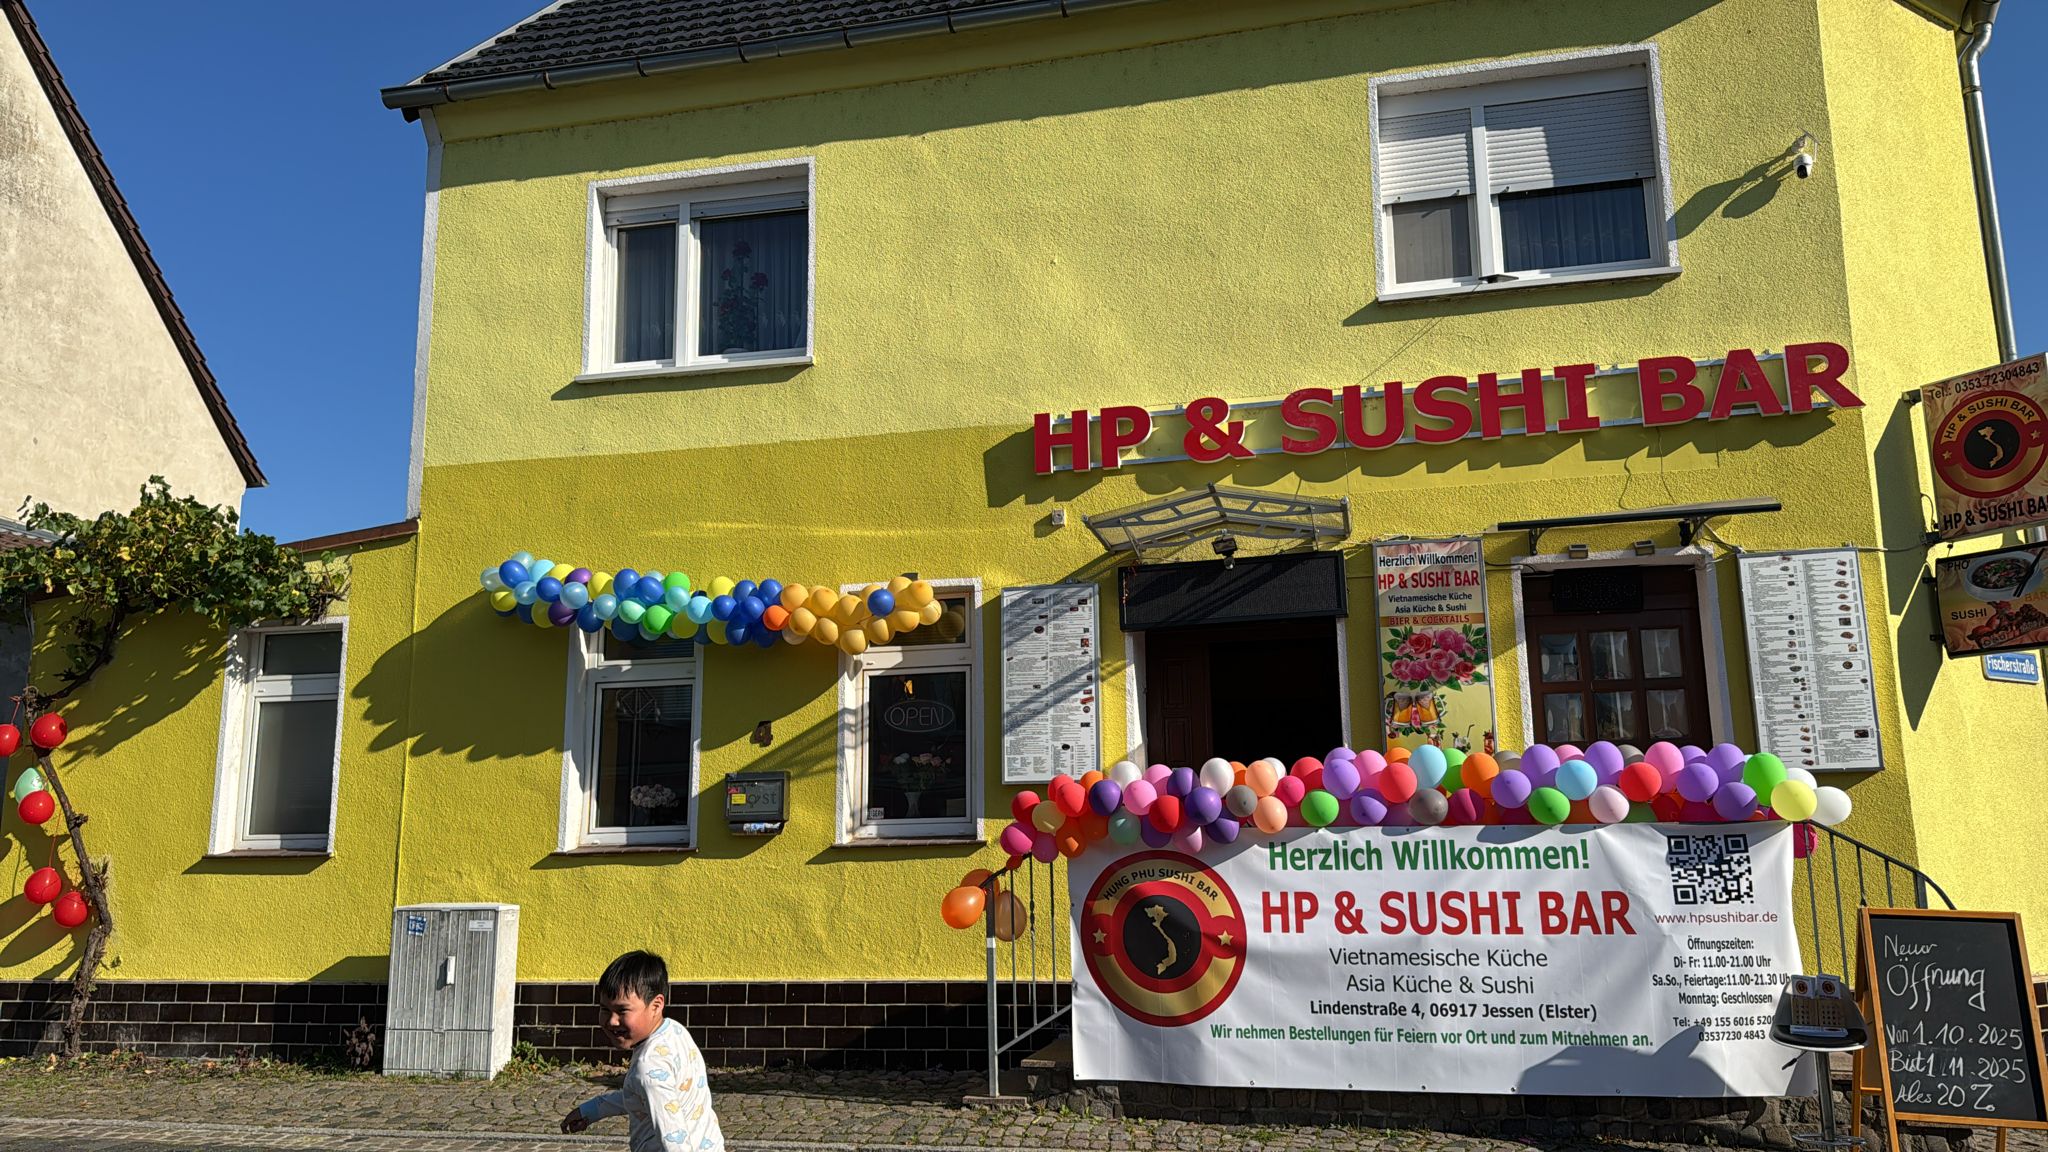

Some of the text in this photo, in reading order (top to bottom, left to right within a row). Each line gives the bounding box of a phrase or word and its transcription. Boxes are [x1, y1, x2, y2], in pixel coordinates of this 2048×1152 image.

[1034, 342, 1866, 476] HP & SUSHI BAR
[1944, 398, 2035, 439] HP & SUSHI BAR
[1943, 495, 2048, 531] HP & SUSHI BA
[1379, 552, 1477, 567] Herzlich Willkommen!
[1378, 570, 1480, 590] HP & SUSHI BAR
[1388, 591, 1473, 603] Vietnamesische Küche
[1395, 603, 1467, 614] Asia Küche & Sushi
[1951, 608, 1987, 620] SUSHI
[1390, 615, 1470, 626] BIER & COCKTAILS
[1986, 655, 2035, 675] Fischerstraße
[890, 706, 944, 727] OPEN
[751, 720, 773, 747] 4
[1269, 839, 1590, 871] Herzlich Willkommen!
[1103, 868, 1218, 901] HUNG PHU SUSHI BAR
[1262, 890, 1638, 936] HP & SUSHI BAR
[1654, 911, 1778, 926] www.hpsushibar.de
[1687, 935, 1755, 953] Öffnungszeiten:
[1329, 947, 1548, 967] Vietnamesische Küche
[1674, 955, 1771, 968] Di- Fr: 11.00-21.00 Uhr
[1346, 975, 1534, 994] Asia Küche & Sushi
[1652, 974, 1682, 988] Sa.So.,
[1887, 957, 1986, 1012] Öffnung
[1678, 992, 1773, 1007] Monntag: Geschlossen
[1310, 1000, 1597, 1022] Lindenstraße 4, 06917 Jessen (Elster)
[1673, 1016, 1690, 1027] Tel:
[1694, 1016, 1712, 1027] +49
[1715, 1016, 1731, 1027] 155
[1733, 1016, 1755, 1026] 6016
[1210, 1024, 1653, 1046] Wir nehmen Bestellungen für Feiern vor Ort und zum Mitnehmen an.
[1699, 1030, 1766, 1042] 03537230 4843
[1886, 1024, 1909, 1045] Von
